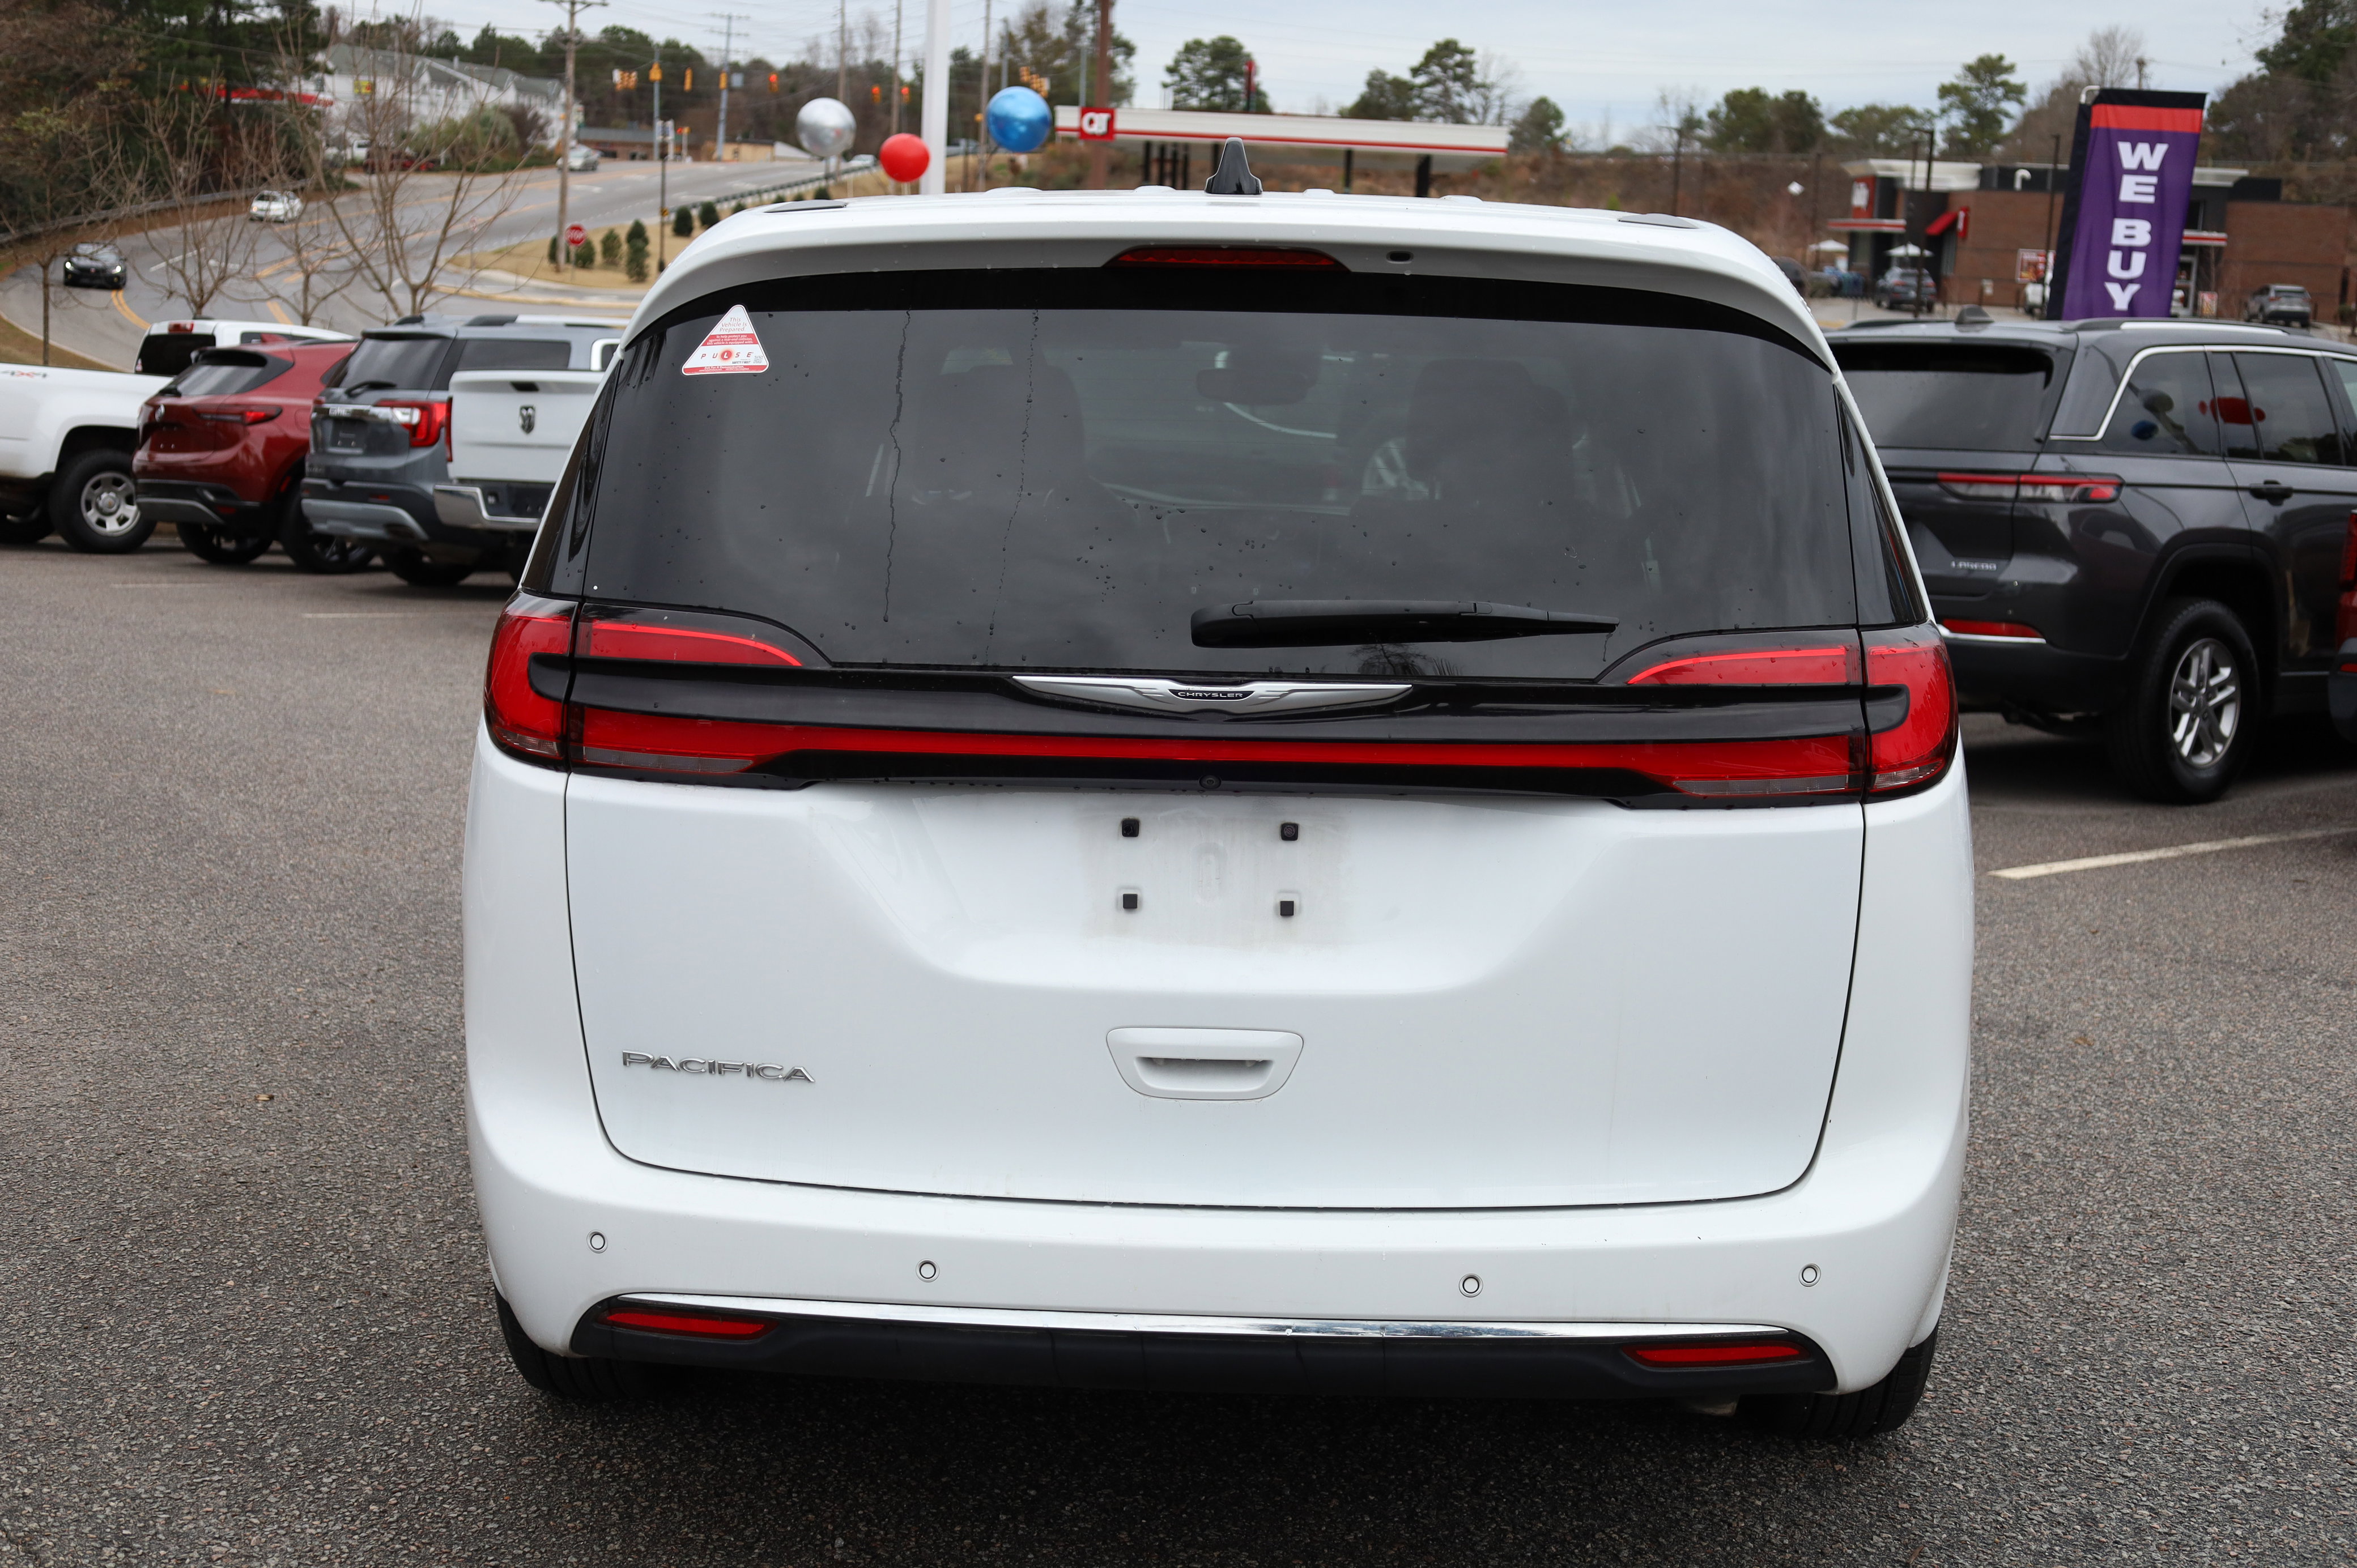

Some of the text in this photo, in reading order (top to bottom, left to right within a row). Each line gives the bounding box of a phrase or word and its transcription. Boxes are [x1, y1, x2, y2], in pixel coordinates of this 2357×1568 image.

[2104, 141, 2169, 311] WE BUY
[623, 1050, 816, 1083] PACIFICA
